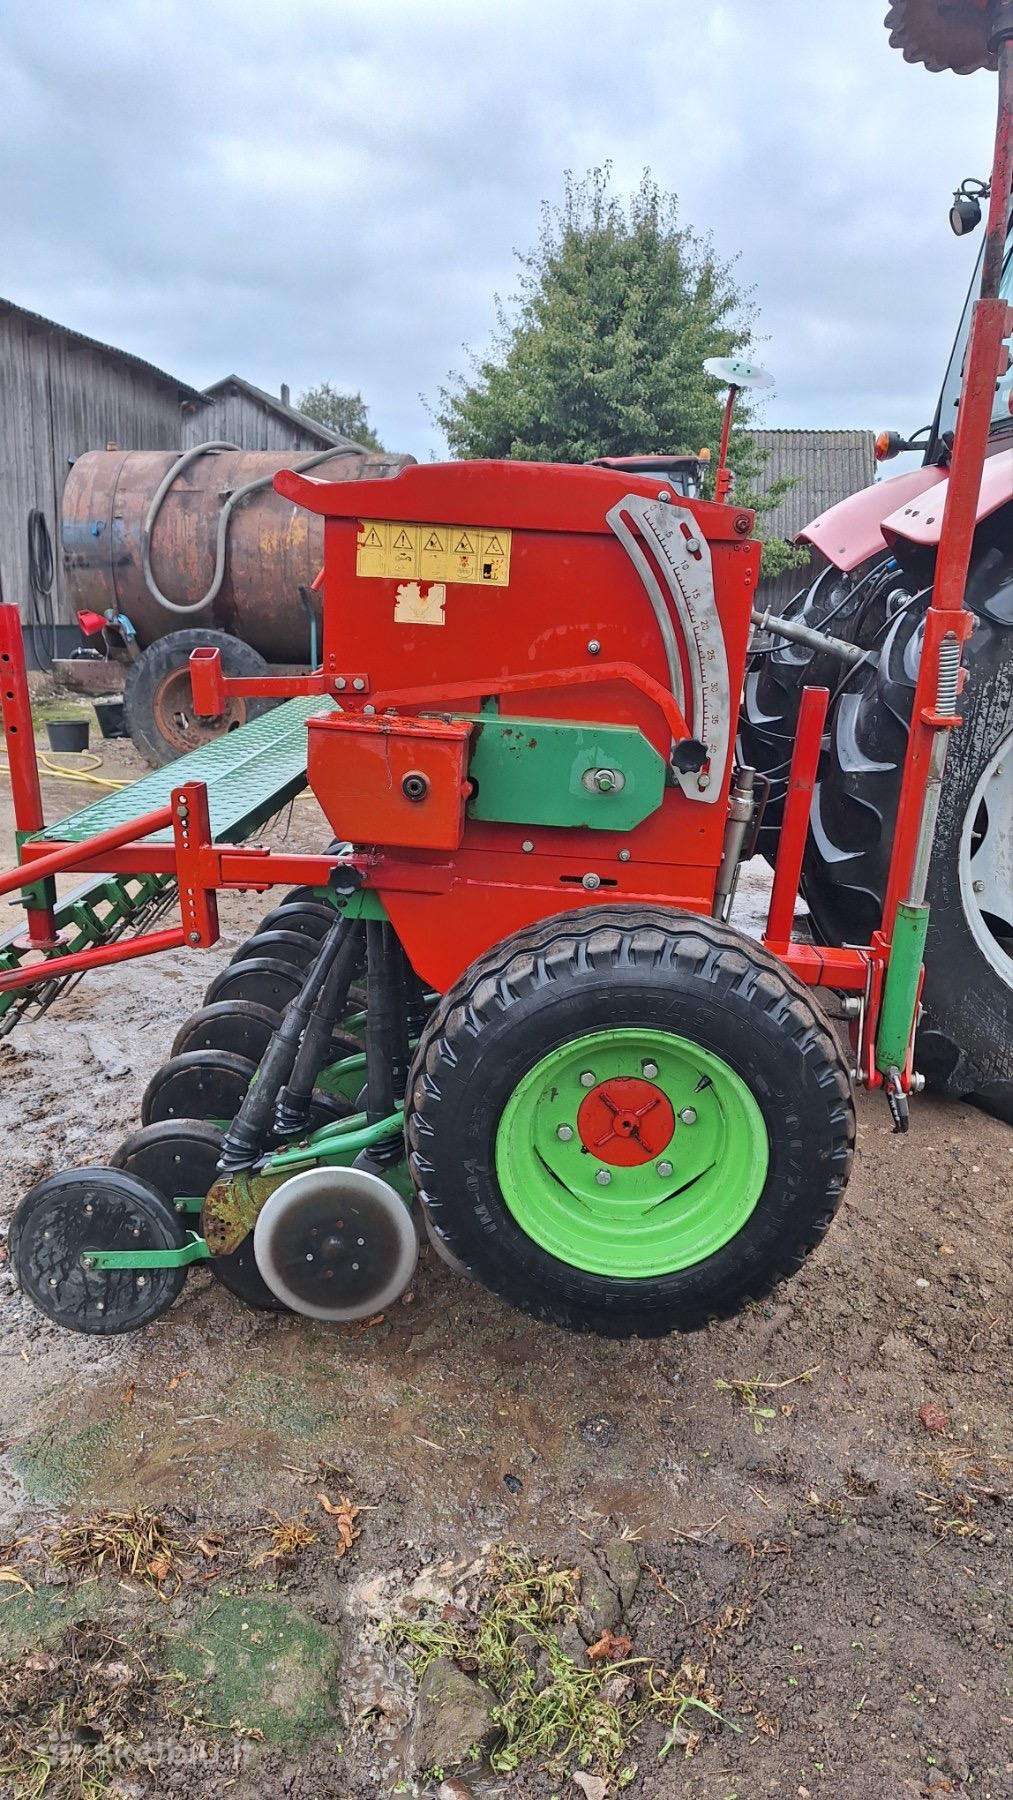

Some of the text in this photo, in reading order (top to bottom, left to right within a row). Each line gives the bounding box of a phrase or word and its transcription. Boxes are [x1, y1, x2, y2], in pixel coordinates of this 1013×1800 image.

[665, 530, 674, 538] 5
[681, 560, 690, 570] 10
[692, 588, 701, 600] 15
[700, 620, 710, 631] 20
[706, 649, 716, 661] 25
[710, 682, 719, 693] 30
[711, 714, 720, 725] 35
